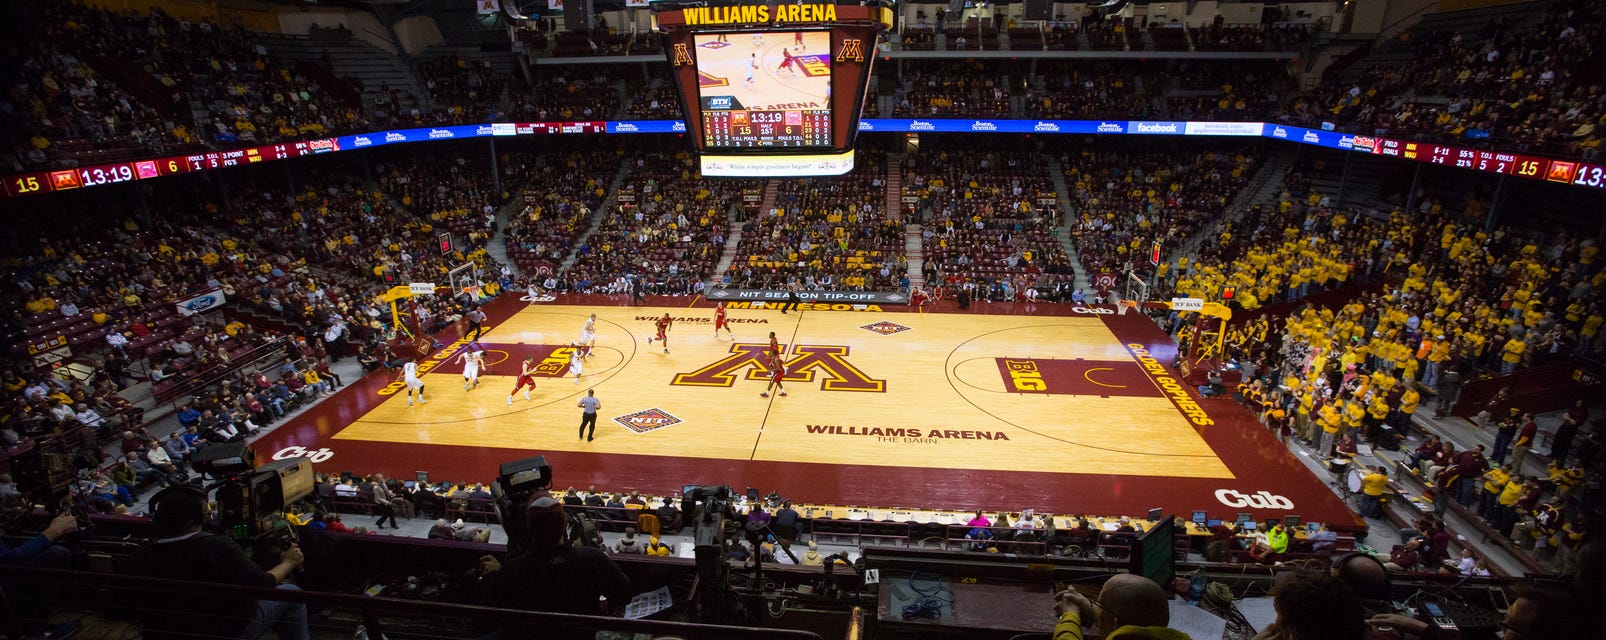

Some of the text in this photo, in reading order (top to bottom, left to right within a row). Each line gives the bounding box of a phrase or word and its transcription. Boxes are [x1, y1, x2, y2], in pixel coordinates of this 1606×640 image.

[683, 4, 837, 25] WILLIAMS ARENA
[674, 43, 693, 66] M
[837, 39, 864, 62] M
[767, 102, 820, 110] ARENA
[751, 113, 782, 122] 13:19
[740, 126, 751, 134] 15
[1137, 123, 1177, 132] facebook
[1434, 147, 1450, 155] 6-11
[169, 160, 178, 173] 6
[194, 159, 218, 170] 1 5
[1480, 160, 1505, 172] 5 2
[1518, 160, 1539, 175] 15
[82, 166, 132, 186] 13:19
[16, 177, 40, 193] 15
[1072, 306, 1114, 314] Cub
[670, 342, 887, 392] M
[1128, 343, 1215, 426] GOLDEN GOPHERS
[806, 425, 1010, 441] WILLIAMS ARENA
[272, 446, 334, 464] Cub
[1215, 488, 1294, 510] Cub
